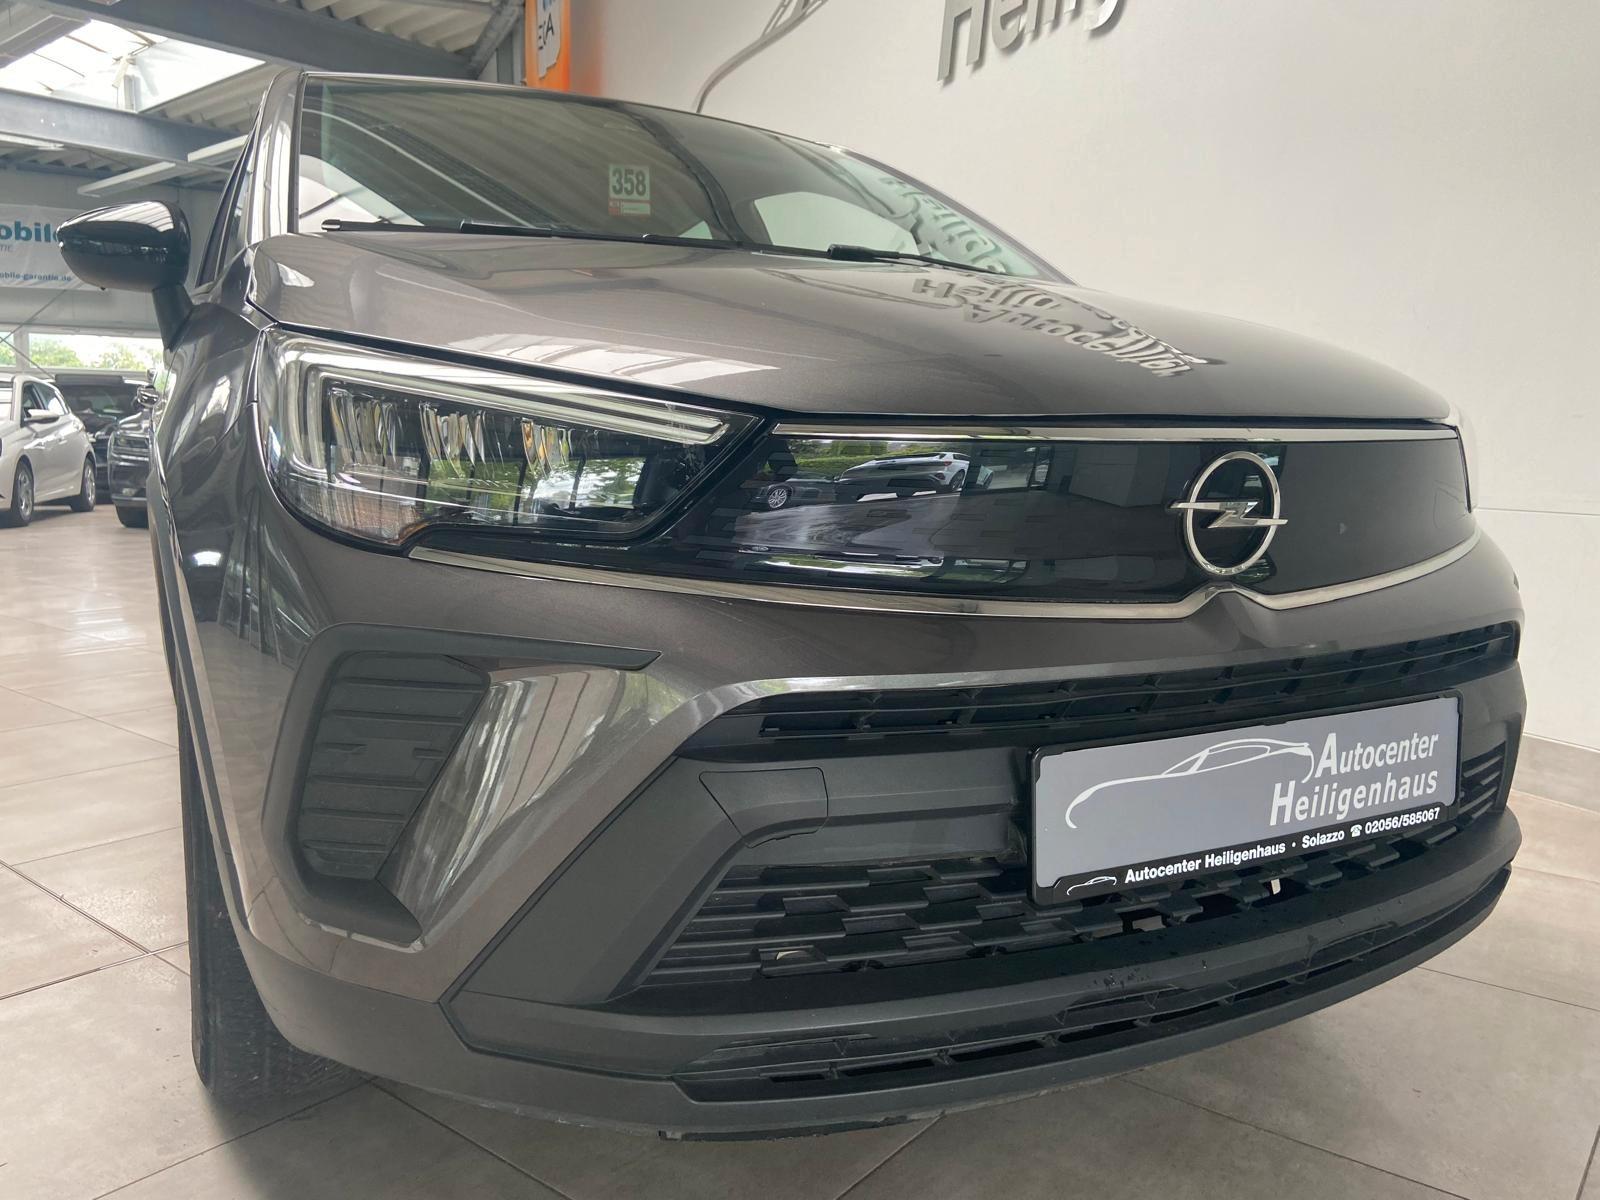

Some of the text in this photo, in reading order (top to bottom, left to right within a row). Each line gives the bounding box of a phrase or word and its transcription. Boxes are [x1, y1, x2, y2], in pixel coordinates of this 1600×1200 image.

[611, 168, 647, 197] 358
[0, 221, 58, 242] obil
[1314, 732, 1440, 778] Autocenter
[1269, 769, 1438, 826] Heiligenhaus
[1124, 806, 1441, 884] Autocenter Heiligenhaus Solazzo 02056/585067
